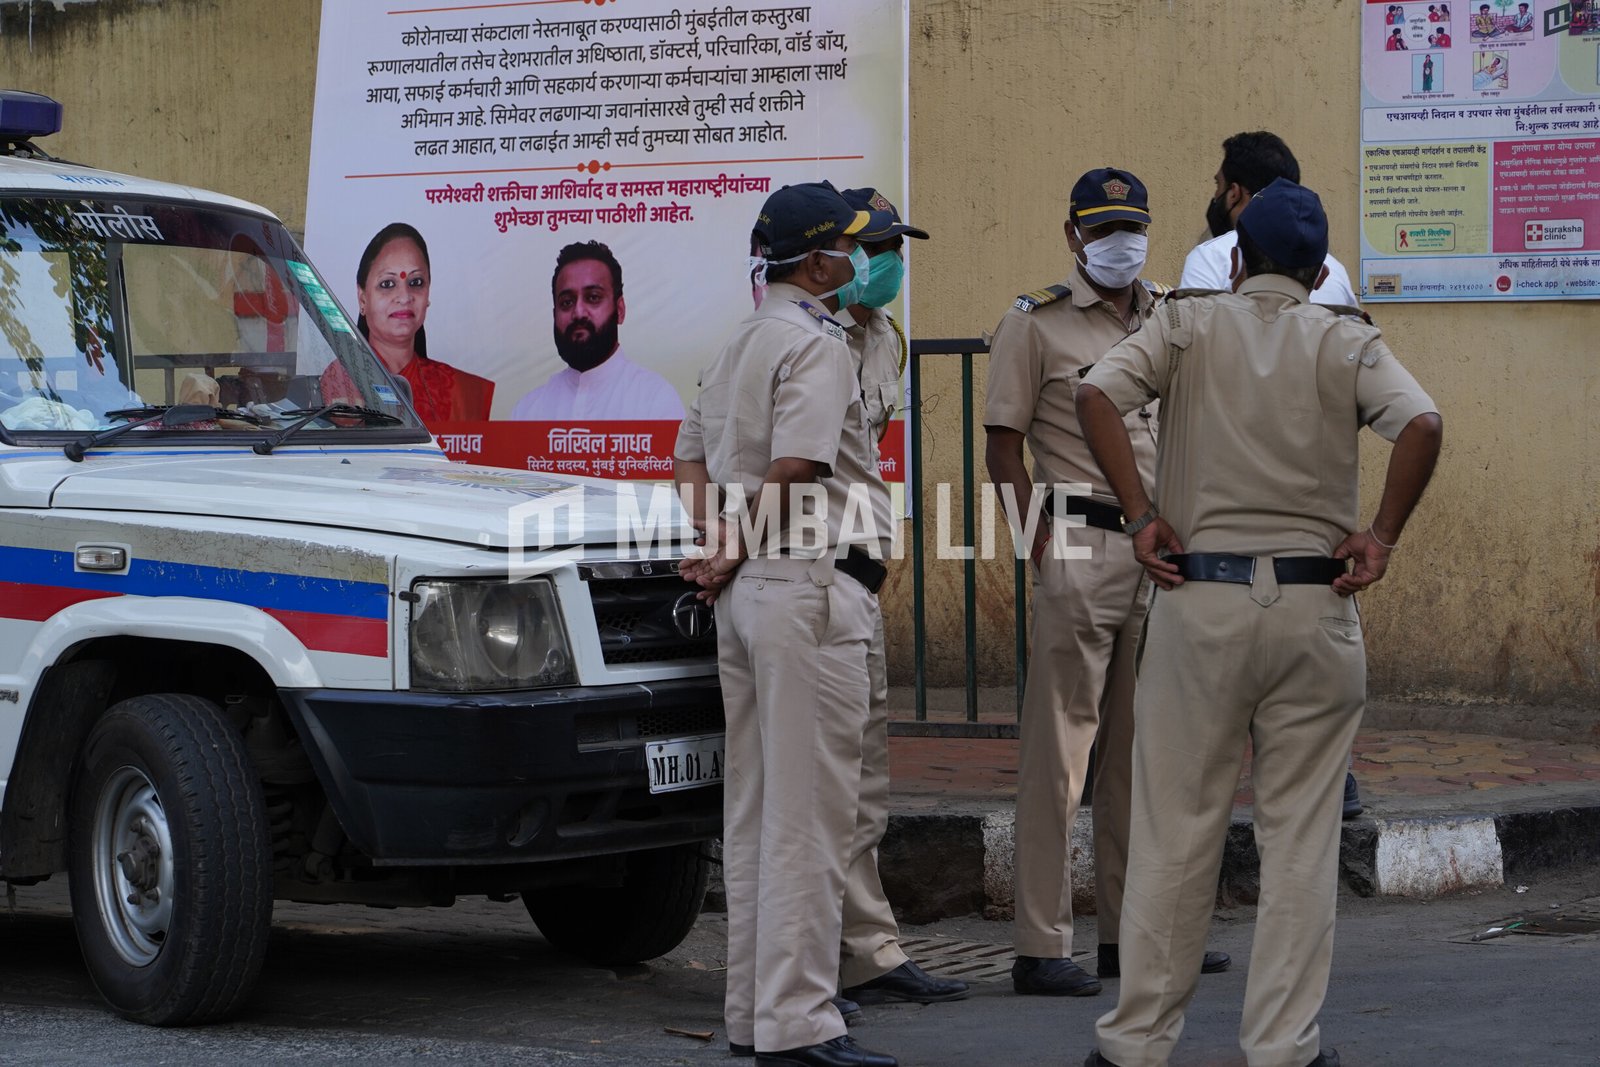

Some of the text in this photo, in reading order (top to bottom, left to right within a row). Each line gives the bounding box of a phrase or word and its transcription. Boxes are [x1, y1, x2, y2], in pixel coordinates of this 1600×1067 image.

[401, 6, 811, 47] कोरोनाच्या संकटाला नेस्तनाबूत करण्यासाठी मुंबईतील कस्तुरबा
[367, 30, 848, 76] रूग्णालयातील तसेच देशभरातील अधिष्ठाता, डॉक्टर्स, परिचारिका, वॉर्ड बॉय,
[366, 88, 401, 104] आया,
[404, 80, 445, 103] सफाई
[448, 76, 502, 100] कर्मचारी
[505, 74, 541, 96] आणि
[543, 71, 598, 95] सहकार्य
[751, 65, 811, 85] आम्हाला
[814, 58, 848, 81] सार्थ
[401, 108, 454, 129] अभिमान
[457, 105, 487, 127] आहे.
[490, 104, 536, 126] सिमेवर
[605, 95, 691, 120] जवानांसारखे
[693, 93, 726, 121] तुम्ही
[729, 92, 755, 114] सर्व
[759, 89, 806, 112] शक्तीने
[1386, 108, 1429, 122] एचआयव्ही
[1432, 109, 1456, 120] निदान
[1458, 111, 1464, 119] व
[1467, 109, 1493, 118] उपचार
[1495, 106, 1511, 117] सेवा
[1513, 105, 1547, 119] मुंबईतील
[1549, 103, 1563, 114] सर्व
[1565, 102, 1595, 113] सरकारी
[414, 120, 788, 157] लढत आहात, या लढाईत आम्ही सर्व तुमच्या सोबत आहोत.
[1551, 121, 1580, 130] उपलब्ध
[425, 173, 771, 205] परमेश्वरी शक्तीचा आशिर्वाद व समस्त महाराष्ट्रीयांच्या
[74, 201, 165, 241] पोलीस
[494, 201, 694, 233] शुभेच्छा तुमच्या पाठीशी आहेत.
[1544, 225, 1582, 234] suraksha
[1516, 280, 1559, 289] i-check app
[442, 434, 483, 453] जाधव
[548, 428, 653, 453] निखिल जाधव
[527, 456, 554, 471] सिनेट
[556, 460, 589, 473] सदस्य,
[592, 456, 615, 476] मुंबई
[652, 750, 724, 786] MH.01.A
